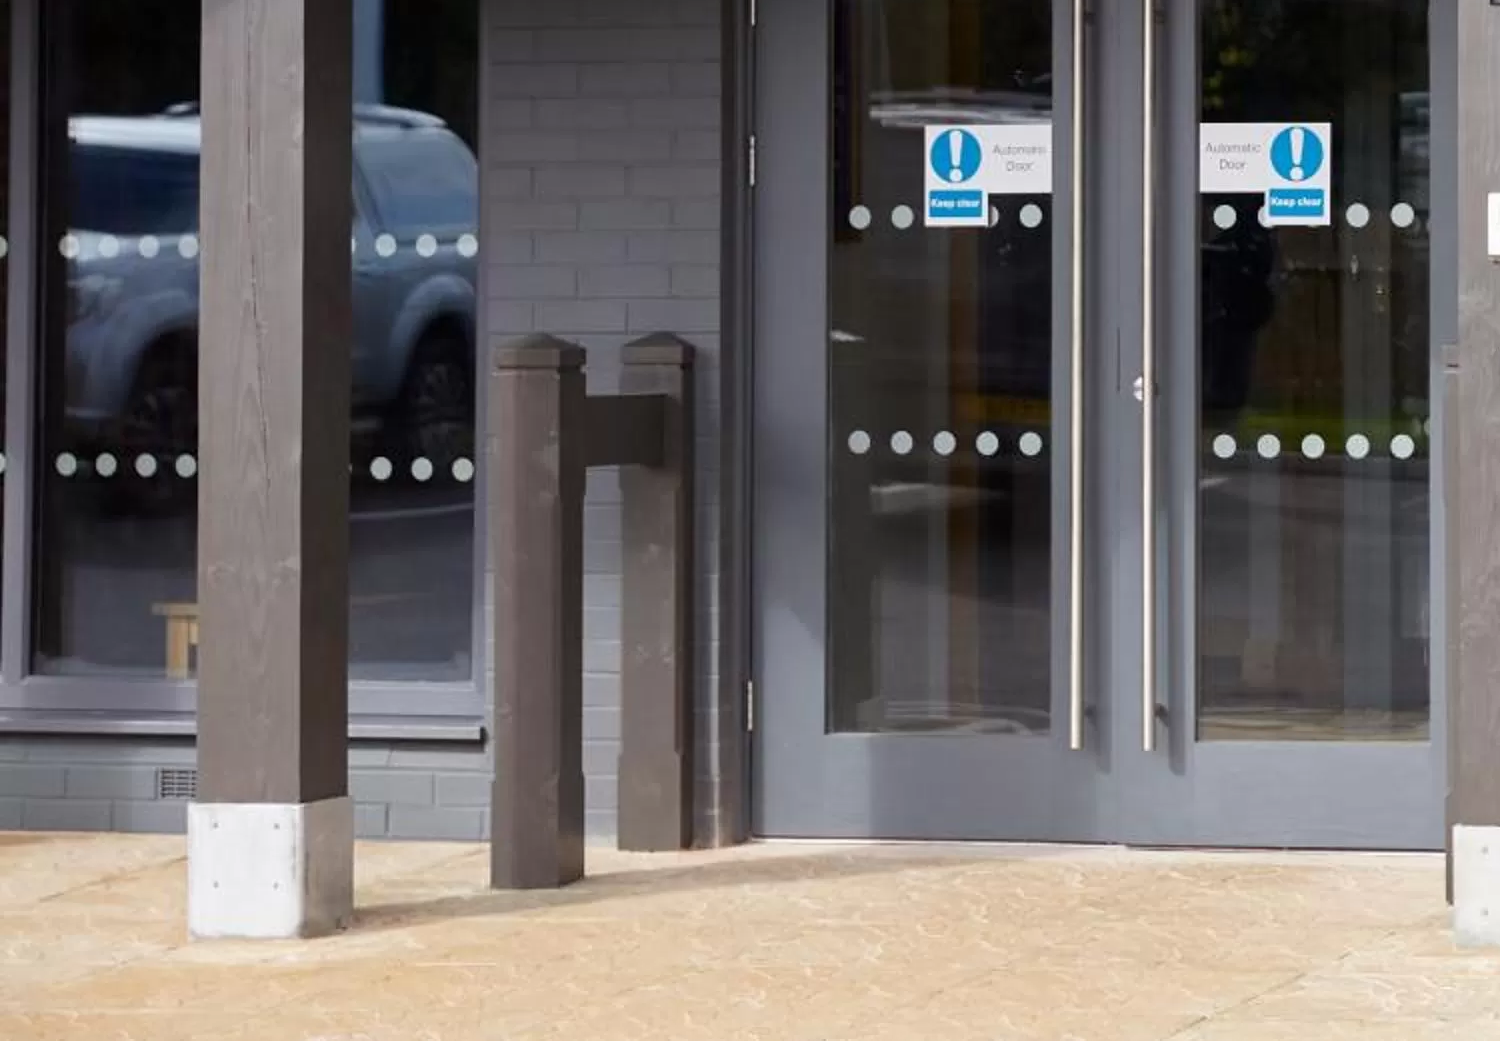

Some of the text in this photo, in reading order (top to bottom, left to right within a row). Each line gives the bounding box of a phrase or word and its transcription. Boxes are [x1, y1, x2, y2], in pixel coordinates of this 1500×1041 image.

[1205, 142, 1261, 154] Automatic
[1006, 161, 1034, 172] Door
[1219, 159, 1246, 170] Door
[930, 198, 955, 210] Keep
[1270, 196, 1321, 208] Keep clear
